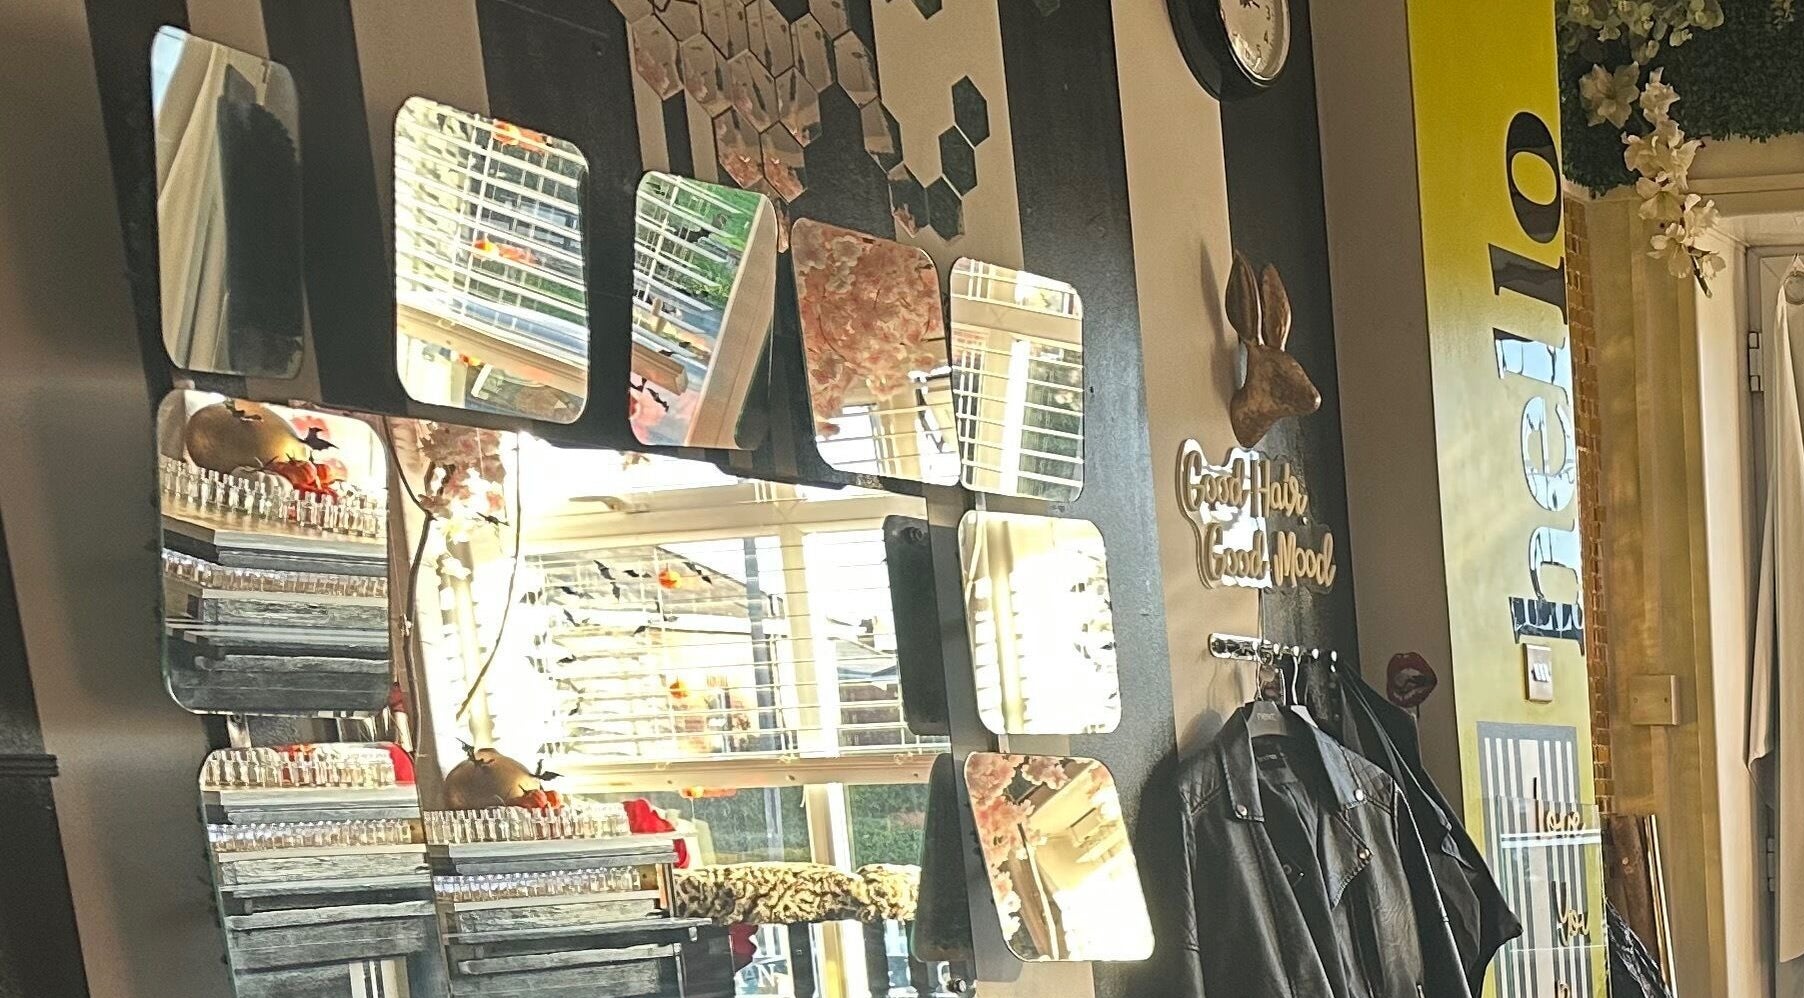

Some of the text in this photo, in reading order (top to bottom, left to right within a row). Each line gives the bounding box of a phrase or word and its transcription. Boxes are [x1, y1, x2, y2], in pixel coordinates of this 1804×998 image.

[1488, 111, 1585, 657] hello
[1184, 450, 1308, 518] Good Hair
[1205, 522, 1336, 588] Good Mood
